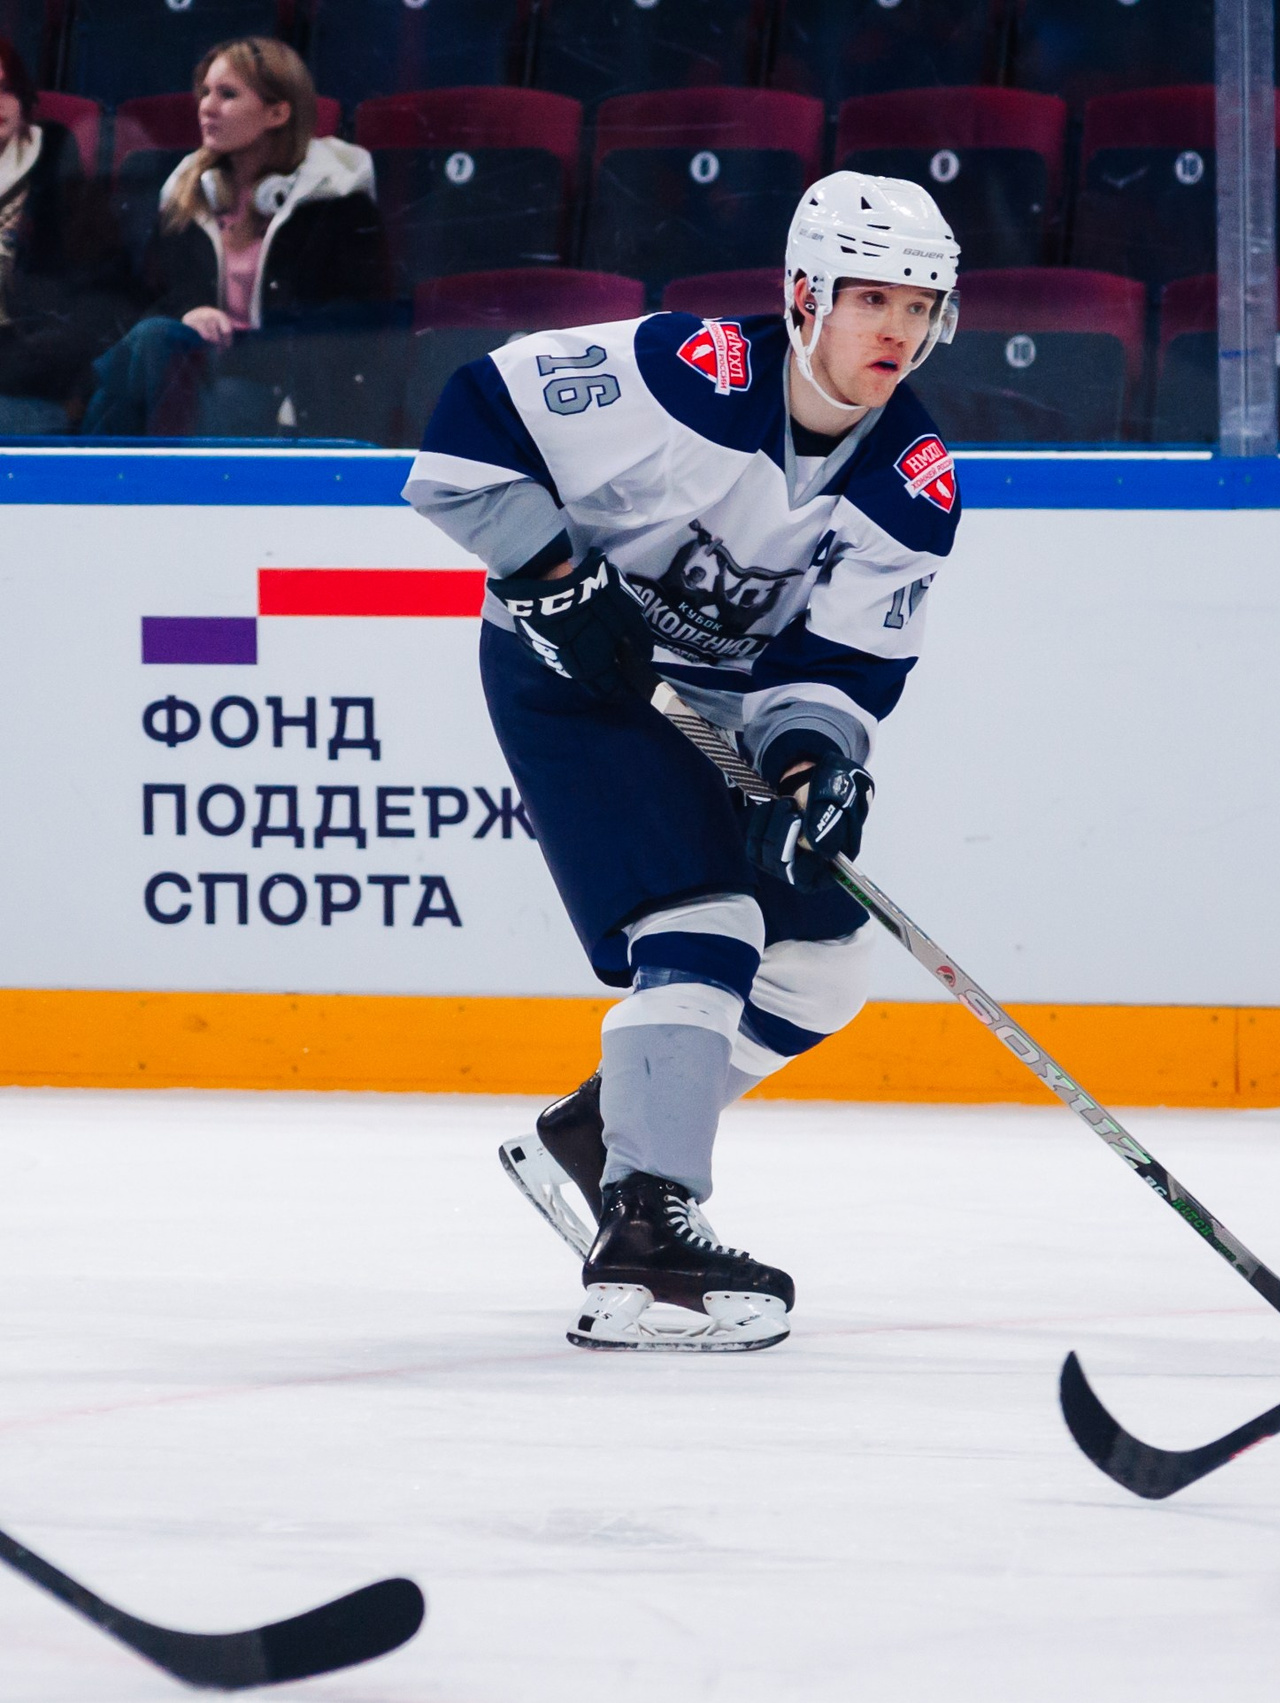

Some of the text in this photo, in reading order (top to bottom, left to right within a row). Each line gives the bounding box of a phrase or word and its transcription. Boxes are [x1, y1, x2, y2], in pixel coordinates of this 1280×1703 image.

[535, 344, 622, 417] 16
[505, 561, 610, 617] CCM
[678, 601, 724, 632] КУБОК
[142, 695, 381, 761] ФОНД
[144, 871, 463, 927] СПОРТА
[957, 988, 1152, 1169] SOYUZ
